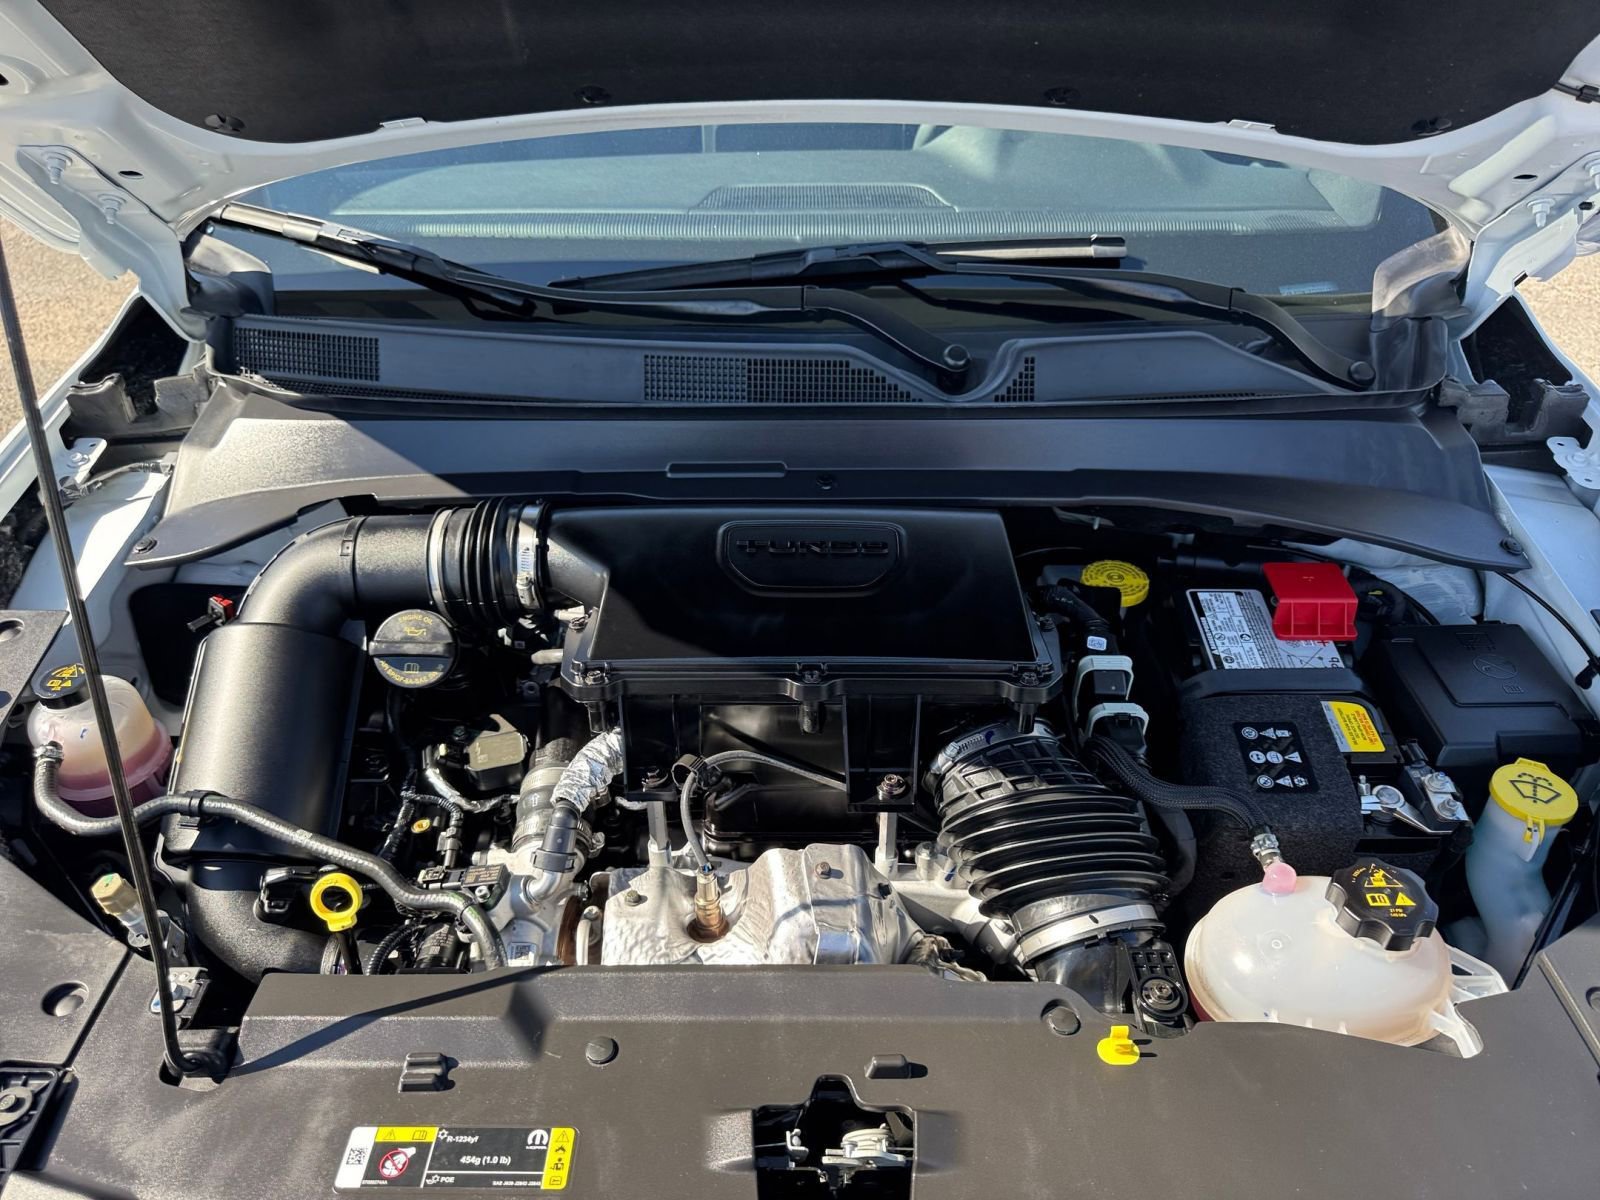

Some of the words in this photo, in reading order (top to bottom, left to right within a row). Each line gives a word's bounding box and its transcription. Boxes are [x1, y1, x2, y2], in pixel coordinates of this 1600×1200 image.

[446, 1135, 480, 1144] R-1234yf
[460, 1155, 481, 1166] 454g
[482, 1155, 498, 1166] (1.0
[499, 1155, 512, 1166] lb)
